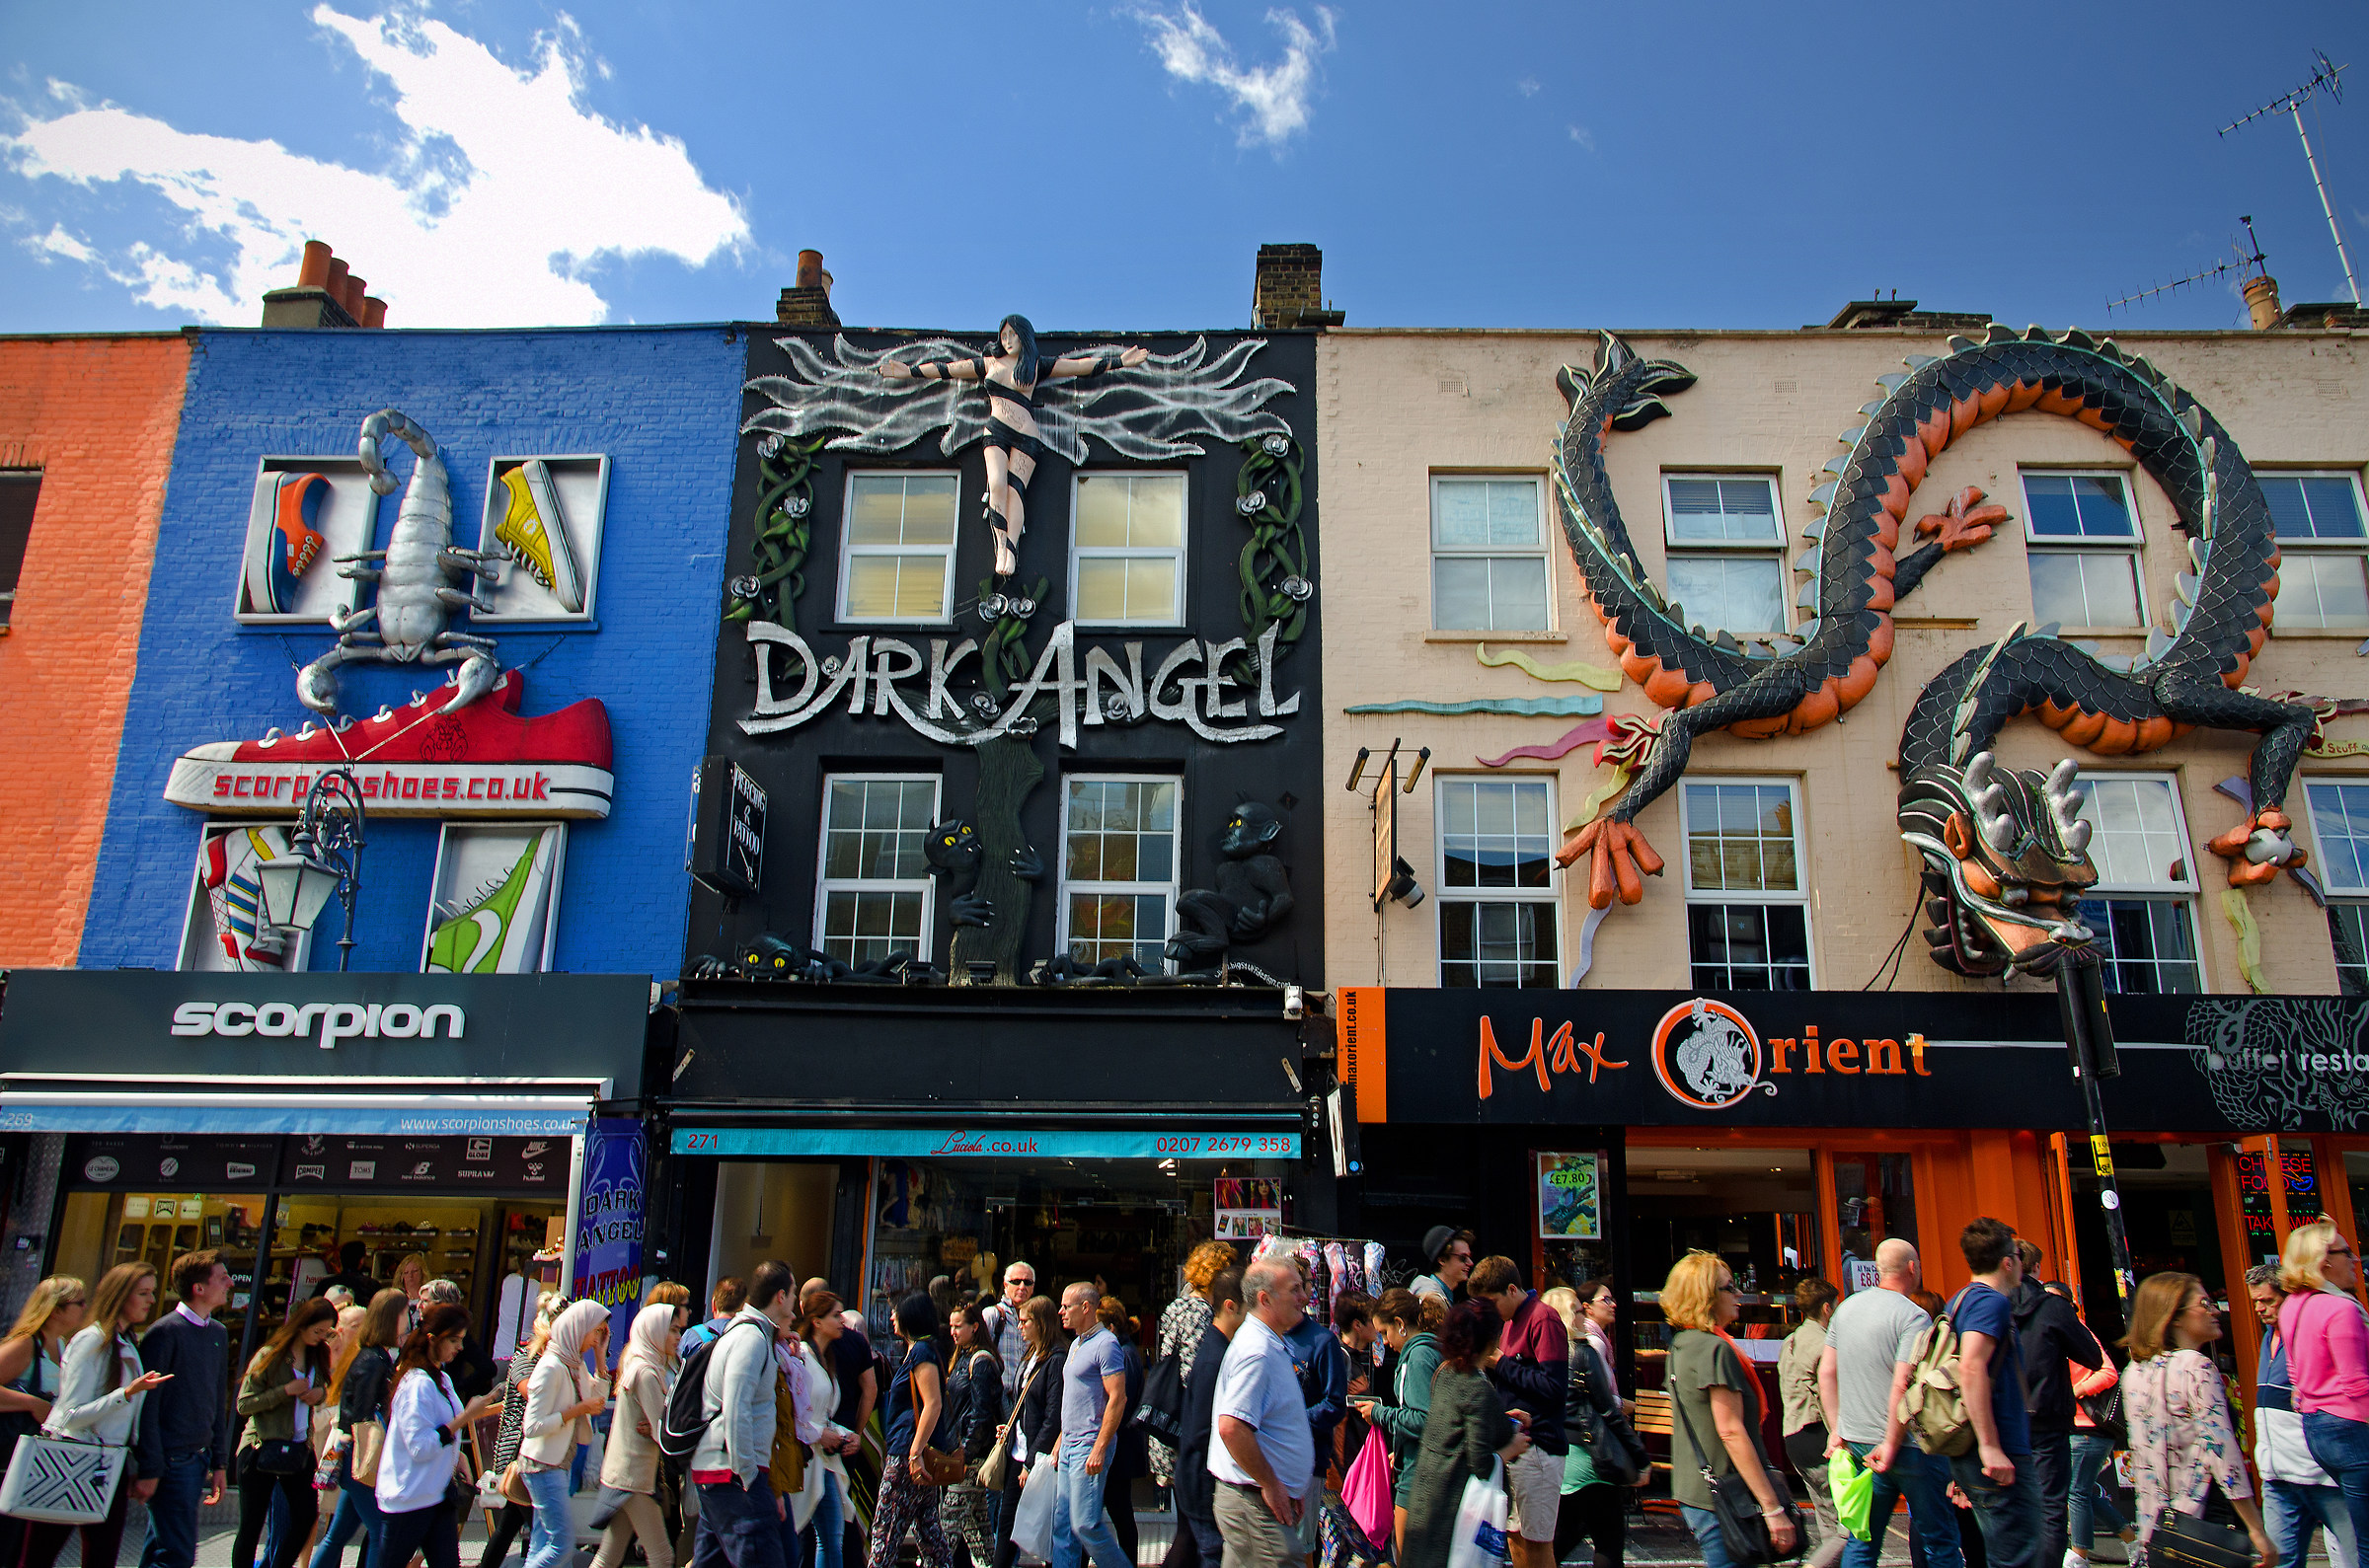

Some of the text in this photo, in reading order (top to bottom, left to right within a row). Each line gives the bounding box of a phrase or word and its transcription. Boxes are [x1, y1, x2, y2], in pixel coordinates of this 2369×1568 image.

[736, 620, 1300, 750] DARK ANGEL
[2328, 741, 2358, 754] Stuff
[171, 1002, 466, 1049] scorpion
[5, 1112, 33, 1127] 269
[400, 1116, 578, 1132] www.scorpionshoes.co.uk
[526, 1141, 548, 1152] NIKE
[687, 1134, 719, 1149] 271
[1157, 1137, 1291, 1153] 0207 2679 358
[2239, 1157, 2313, 1172] CHESE
[1556, 1172, 1585, 1185] £7.80
[584, 1186, 642, 1220] DARK
[576, 1220, 644, 1258] ANGEL
[231, 1274, 253, 1283] OPEN
[573, 1263, 642, 1308] TATTOO
